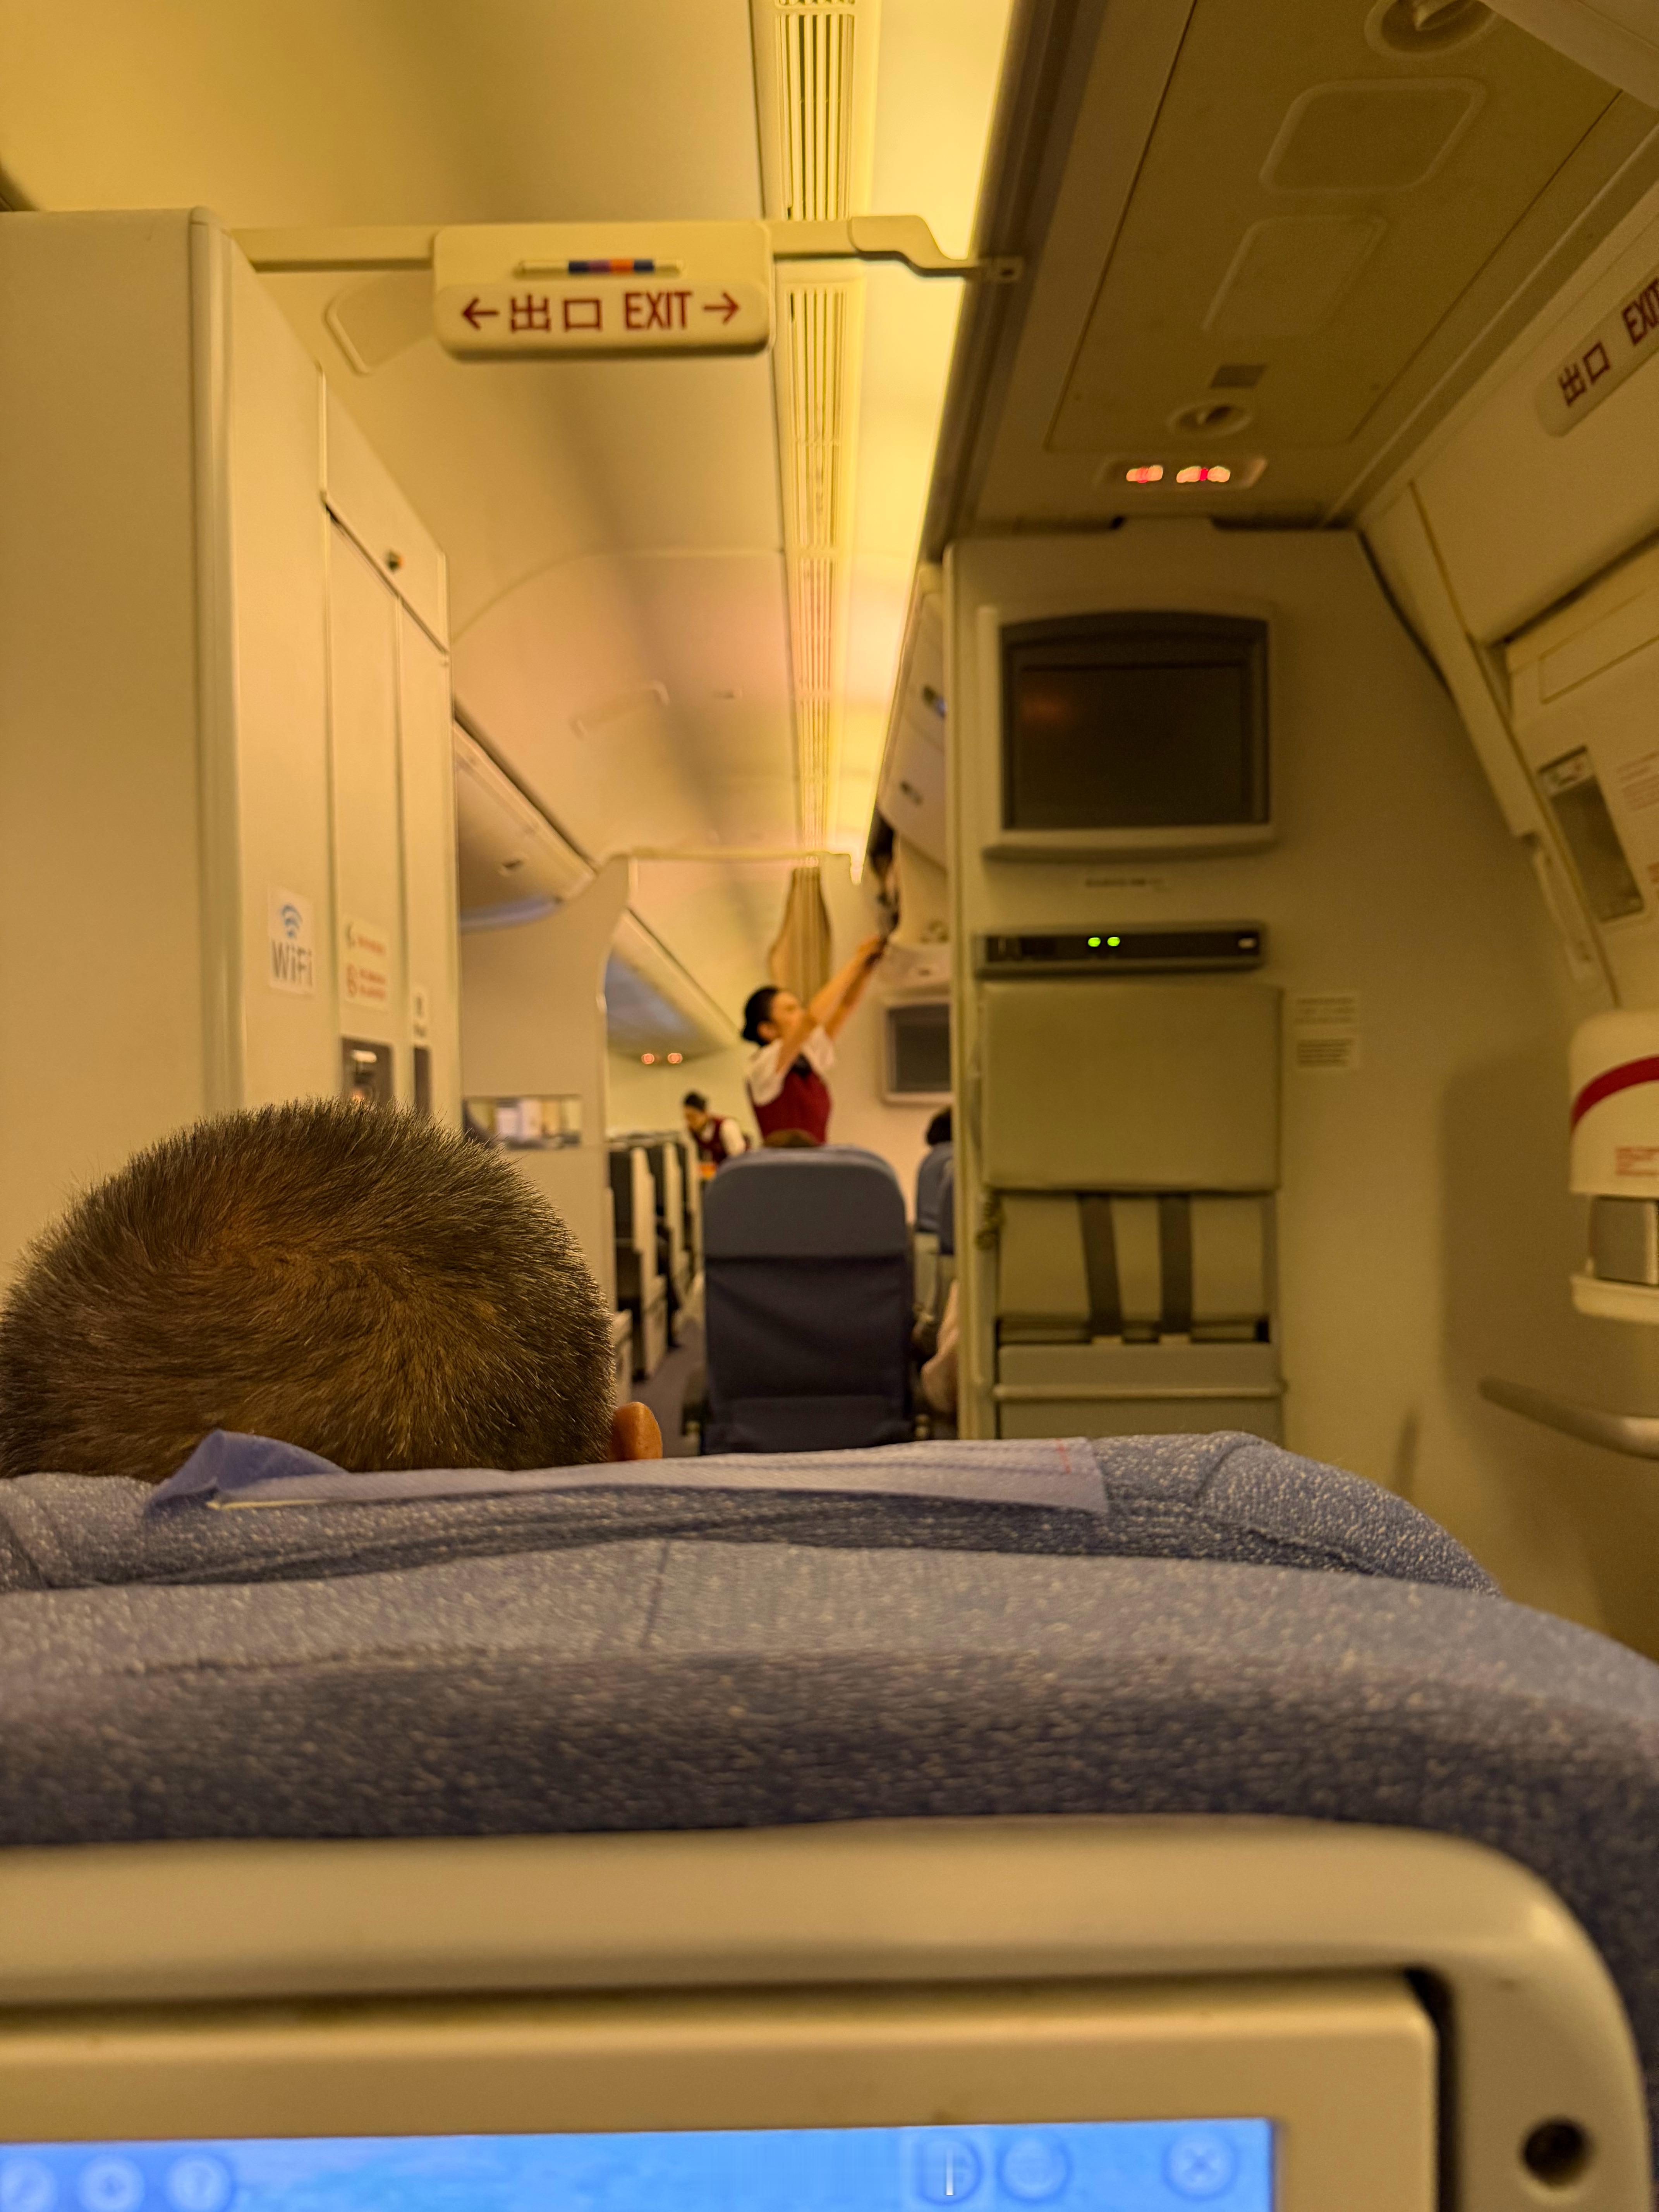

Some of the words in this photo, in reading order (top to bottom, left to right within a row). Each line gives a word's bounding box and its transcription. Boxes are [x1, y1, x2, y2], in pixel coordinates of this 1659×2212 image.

[510, 294, 603, 332] 出口
[624, 291, 692, 330] EXIT
[1558, 340, 1611, 407] 出口
